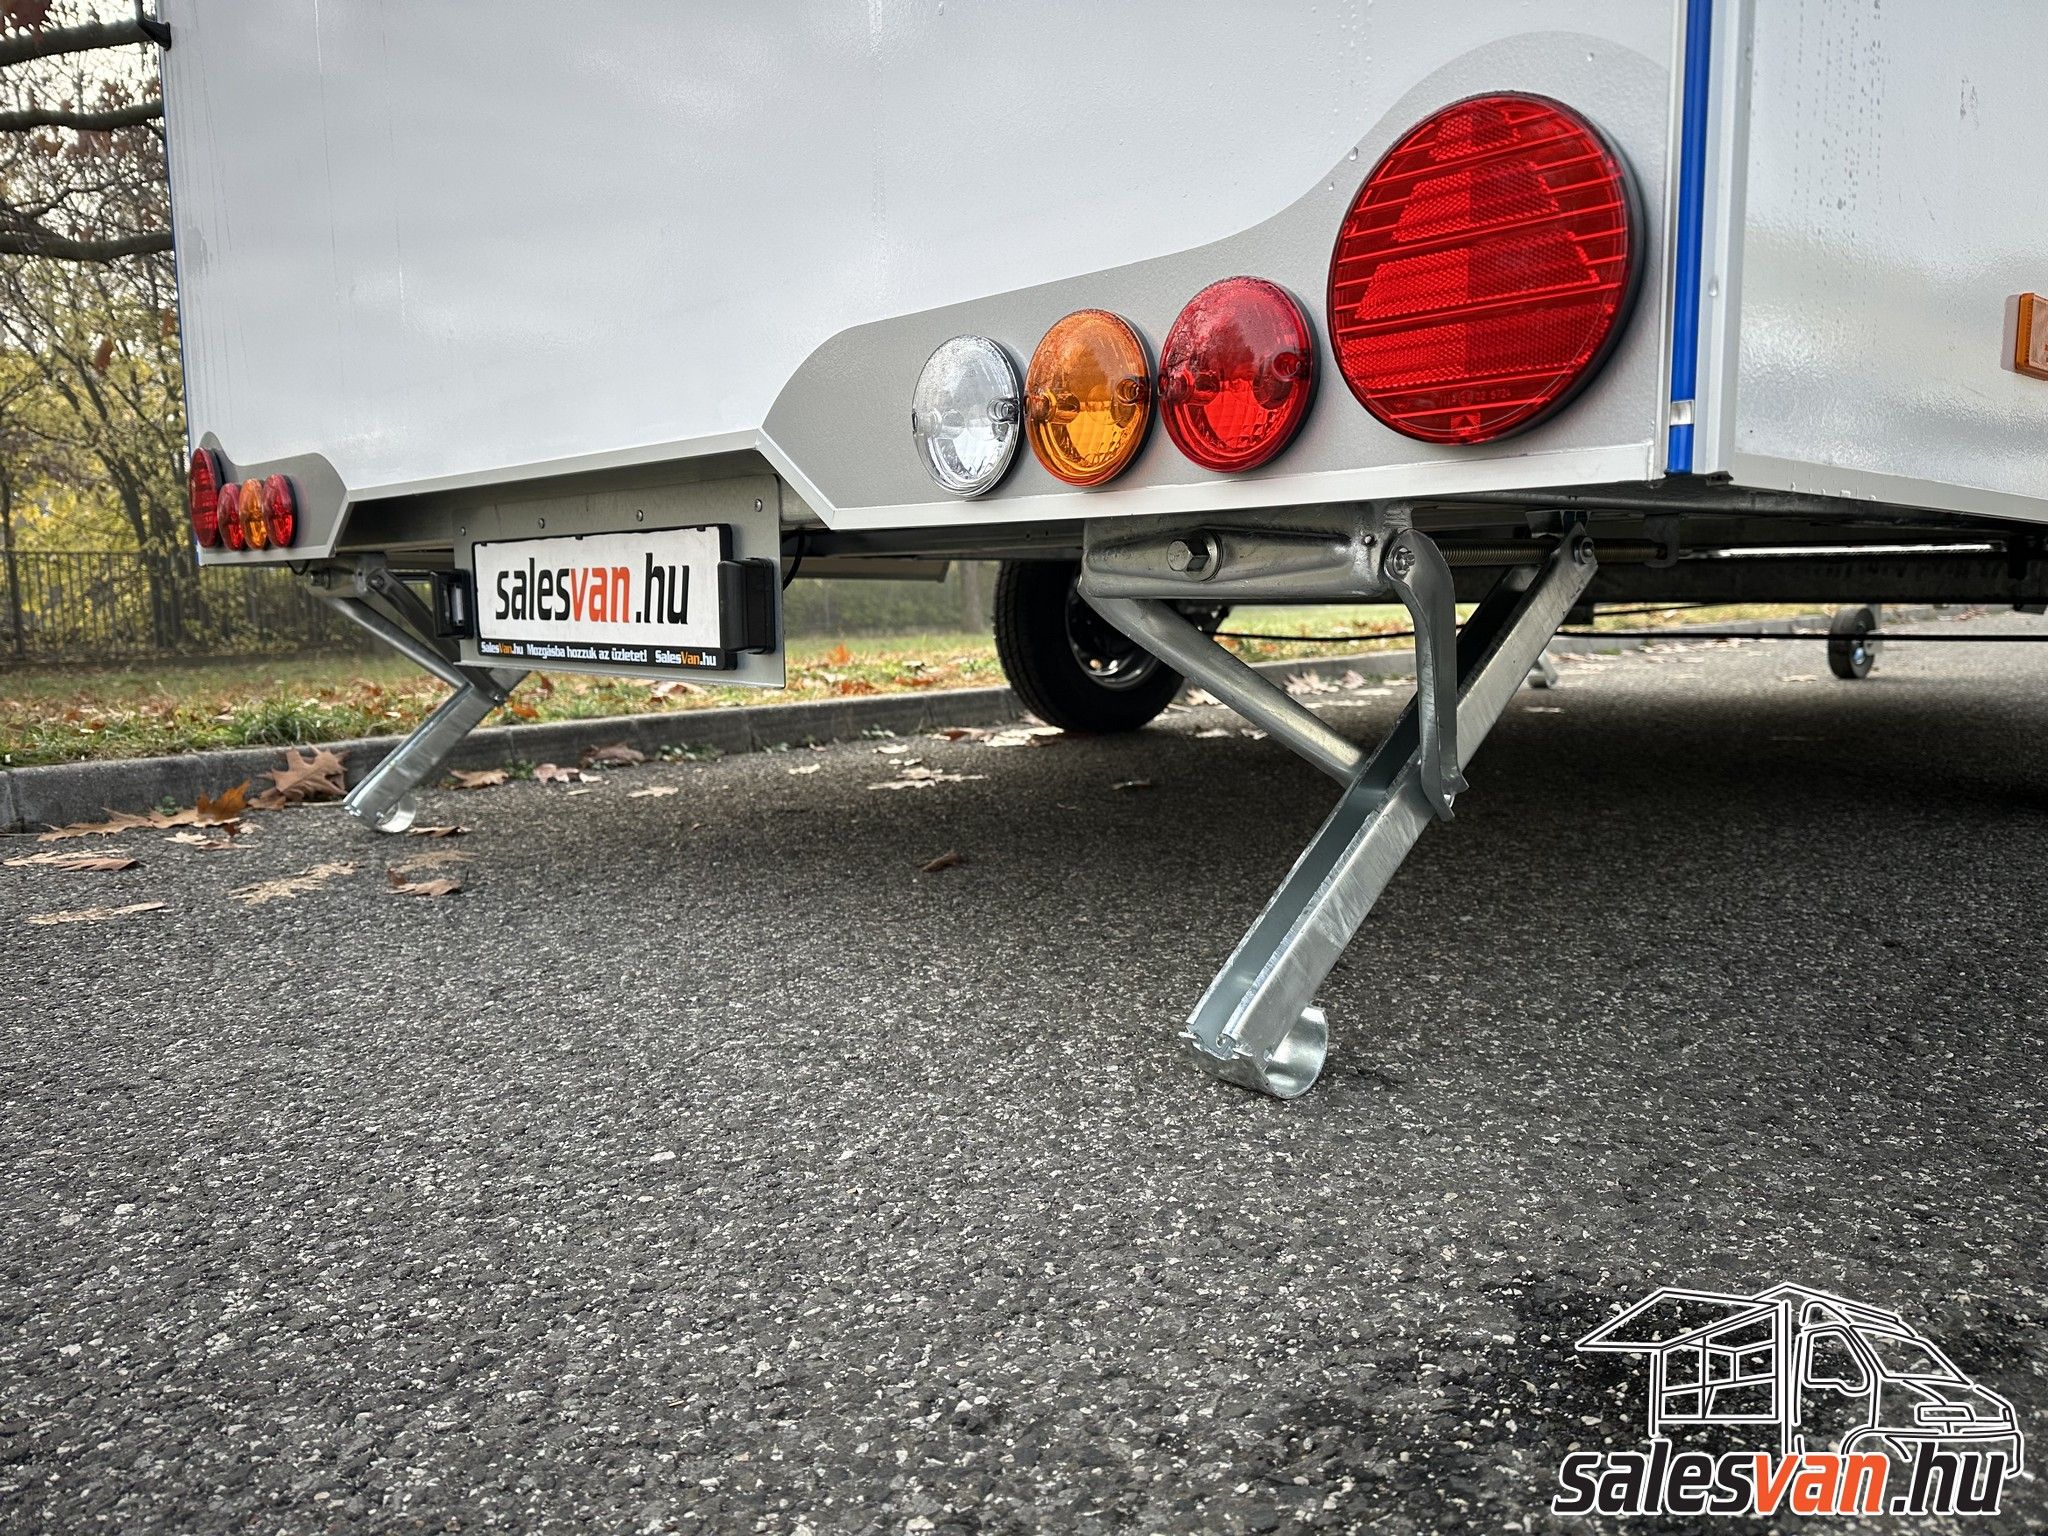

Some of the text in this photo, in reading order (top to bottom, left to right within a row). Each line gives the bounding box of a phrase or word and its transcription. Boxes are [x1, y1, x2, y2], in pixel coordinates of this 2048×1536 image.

[495, 552, 690, 625] salesvan.hu
[480, 641, 524, 655] SalesVan.hu
[526, 643, 566, 659] Mozgásba
[566, 645, 598, 660] hozzuk
[598, 649, 610, 660] az
[655, 649, 717, 666] SalesVan.hu
